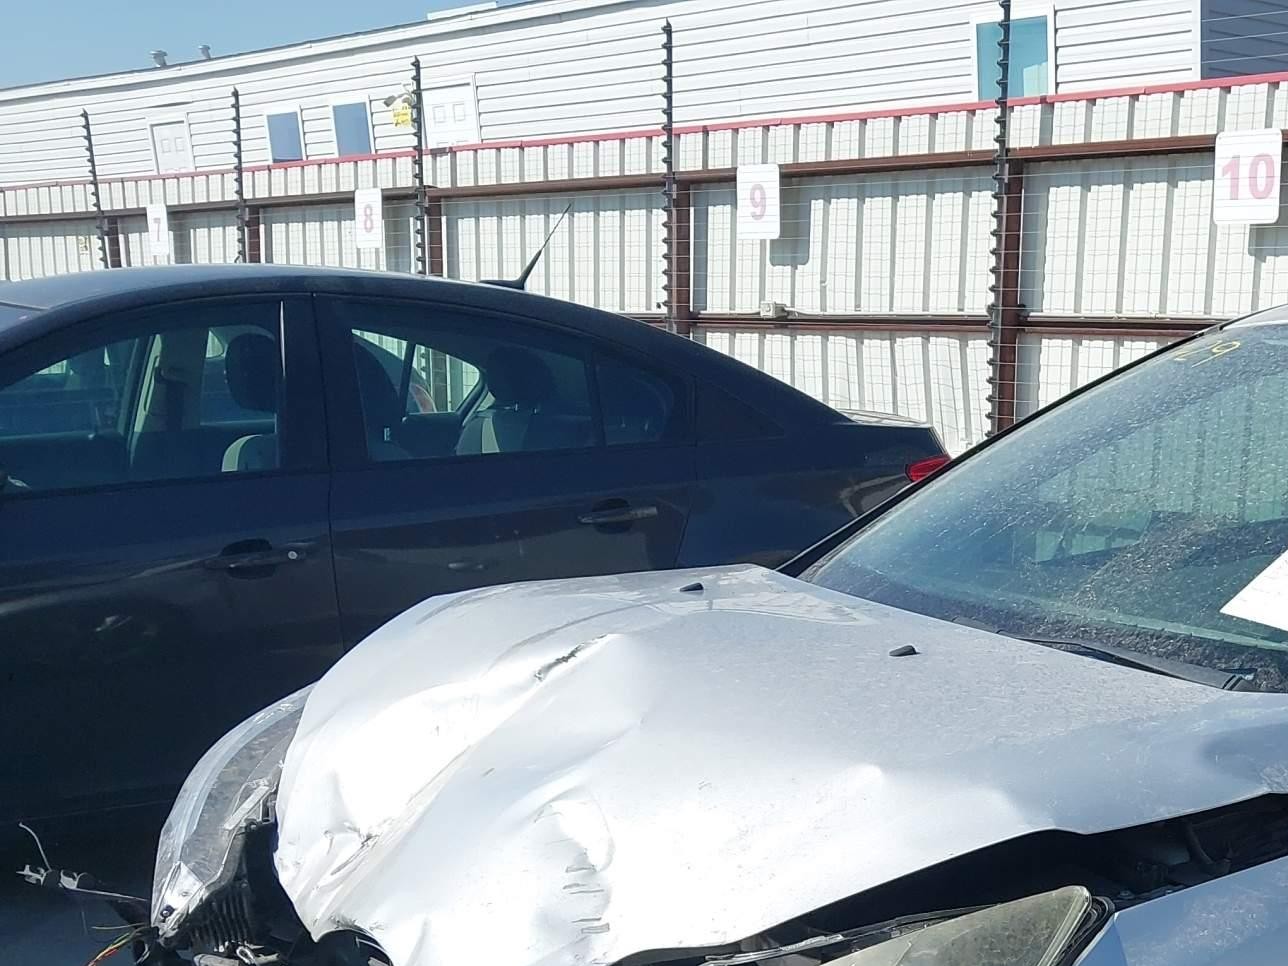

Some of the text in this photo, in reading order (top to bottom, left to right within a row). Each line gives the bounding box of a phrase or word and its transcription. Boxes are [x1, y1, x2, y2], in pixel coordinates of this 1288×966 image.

[1222, 153, 1275, 200] 10
[364, 203, 374, 233] 8
[750, 183, 767, 221] 9
[153, 217, 161, 242] 7
